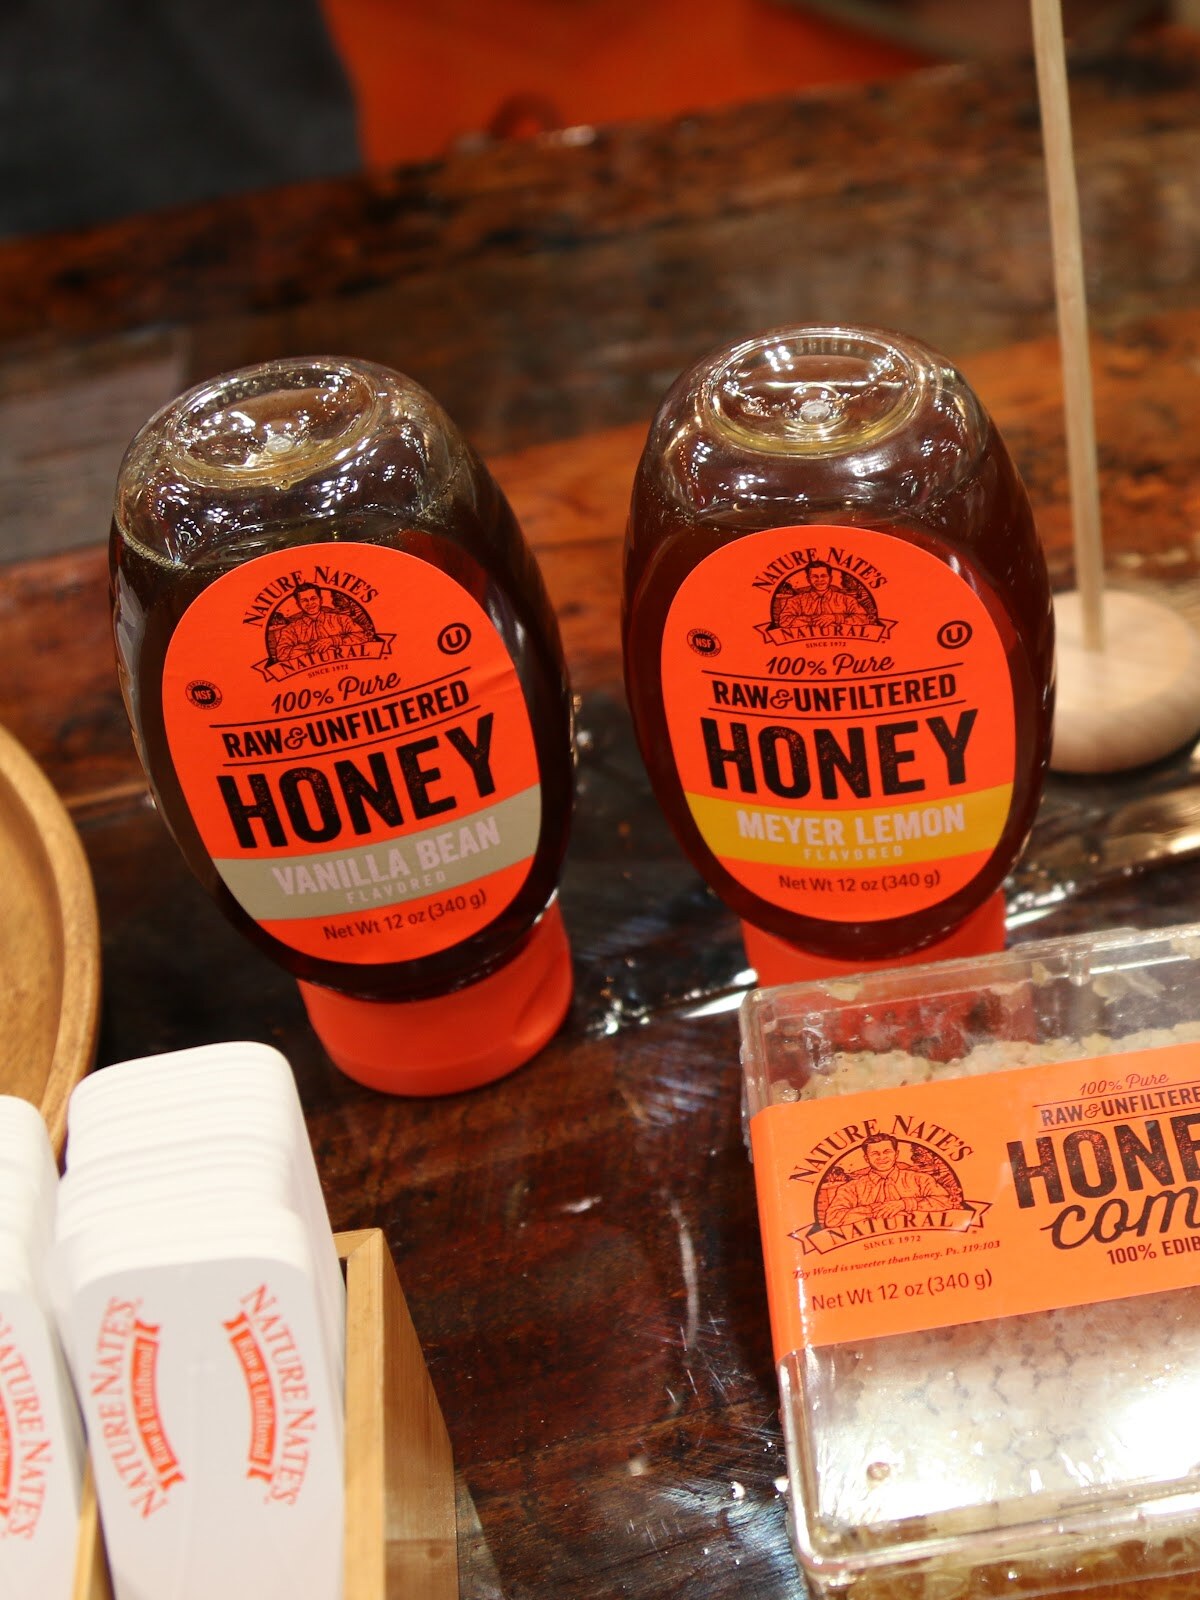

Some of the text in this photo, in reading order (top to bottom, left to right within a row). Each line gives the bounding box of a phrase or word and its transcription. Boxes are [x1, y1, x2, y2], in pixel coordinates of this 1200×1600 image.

[752, 547, 888, 594] NATURE NATE'S
[243, 566, 379, 628] NATURE NATE'S
[781, 626, 869, 641] NATURAL
[280, 645, 369, 675] NATURAL
[308, 667, 330, 678] SINCE
[766, 653, 895, 675] 100% Pure
[271, 672, 401, 714] 100% Pure
[700, 709, 979, 800] HONEY
[216, 712, 496, 848] HONEY
[736, 803, 966, 846] MEYER LEMON
[272, 816, 501, 895] VANILLA BEAN
[803, 846, 904, 861] FLAVORED
[346, 870, 446, 904] FLAVORED
[779, 870, 941, 892] Net Wt 12 oz (340 g)
[323, 889, 487, 940] Net Wt 12 oz (340 g)
[1080, 1074, 1169, 1096] 100% Pure
[789, 1114, 974, 1185] NATURE NATE'S
[828, 1212, 953, 1245] NATURAL
[863, 1235, 921, 1250] SINCE 1972
[813, 1264, 839, 1276] Word
[851, 1259, 886, 1271] sweeter
[888, 1255, 910, 1265] than
[912, 1251, 942, 1261] honey.
[1107, 1243, 1157, 1265] 100%
[812, 1269, 993, 1311] Net Wt 12 oz (340 g)
[240, 1282, 309, 1407] NATURE
[99, 1401, 169, 1519] NATURE
